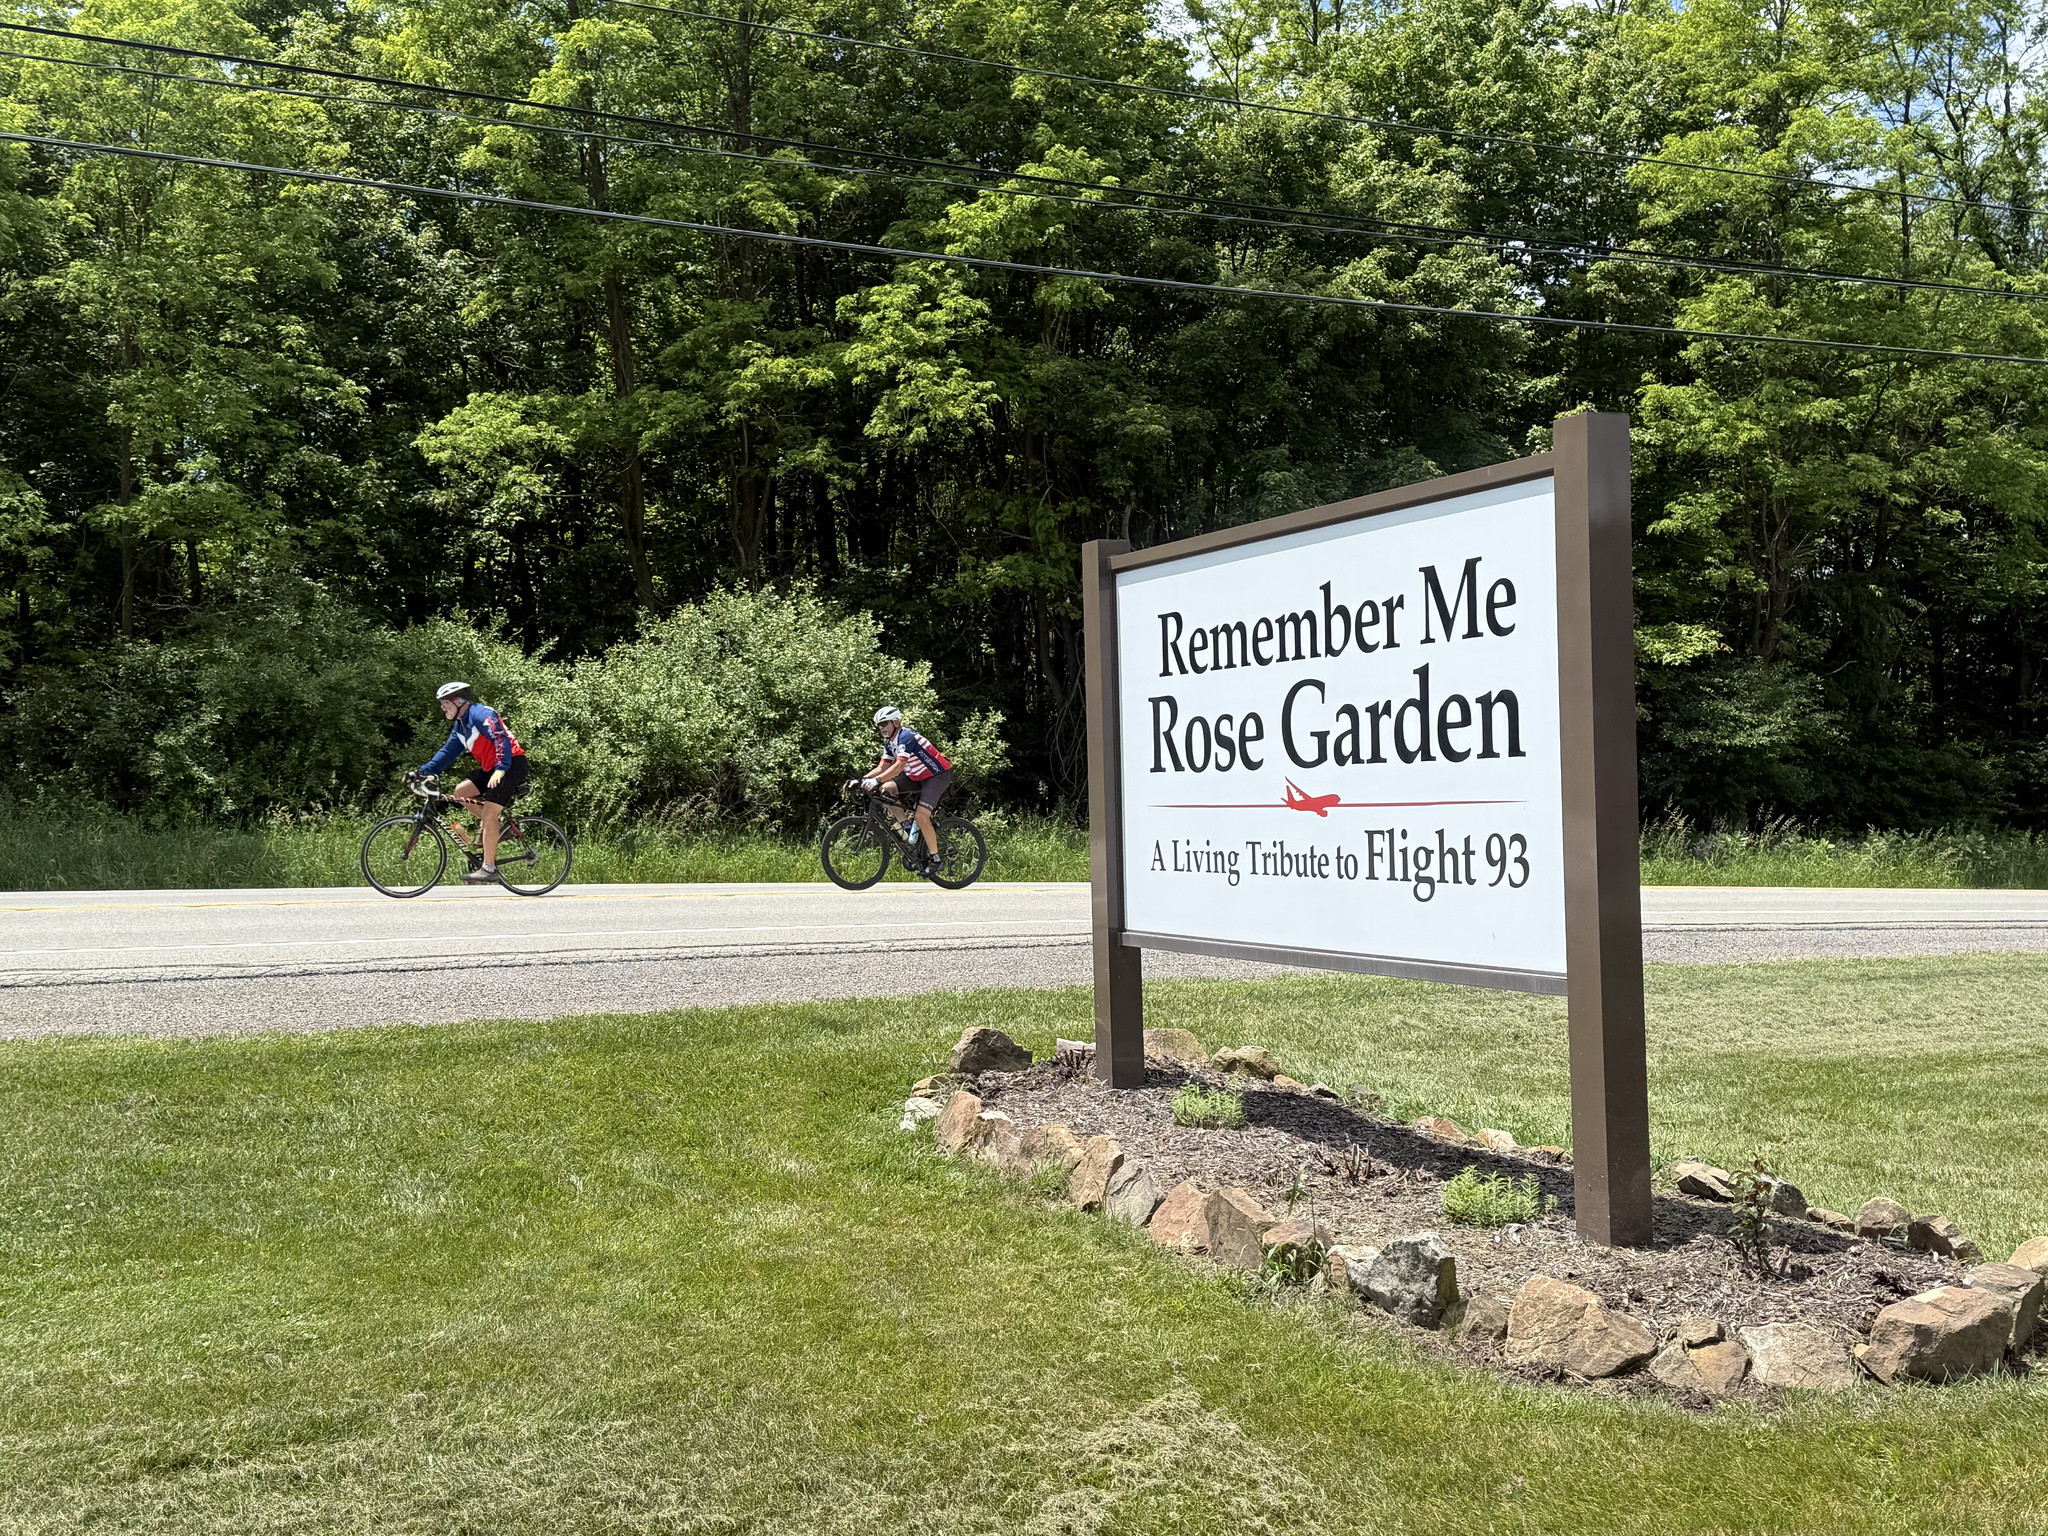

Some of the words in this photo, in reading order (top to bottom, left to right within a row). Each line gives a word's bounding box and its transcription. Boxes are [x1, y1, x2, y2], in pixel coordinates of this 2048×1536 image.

[1157, 580, 1405, 678] Remember
[1418, 556, 1517, 645] Me
[1148, 695, 1265, 774] Rose
[1281, 662, 1527, 769] Garden
[1150, 839, 1167, 872] A
[1171, 839, 1241, 887] Living
[1245, 840, 1330, 879] Tribute
[1335, 845, 1359, 880] to
[1364, 827, 1477, 903] Flight
[1485, 832, 1531, 889] 93
